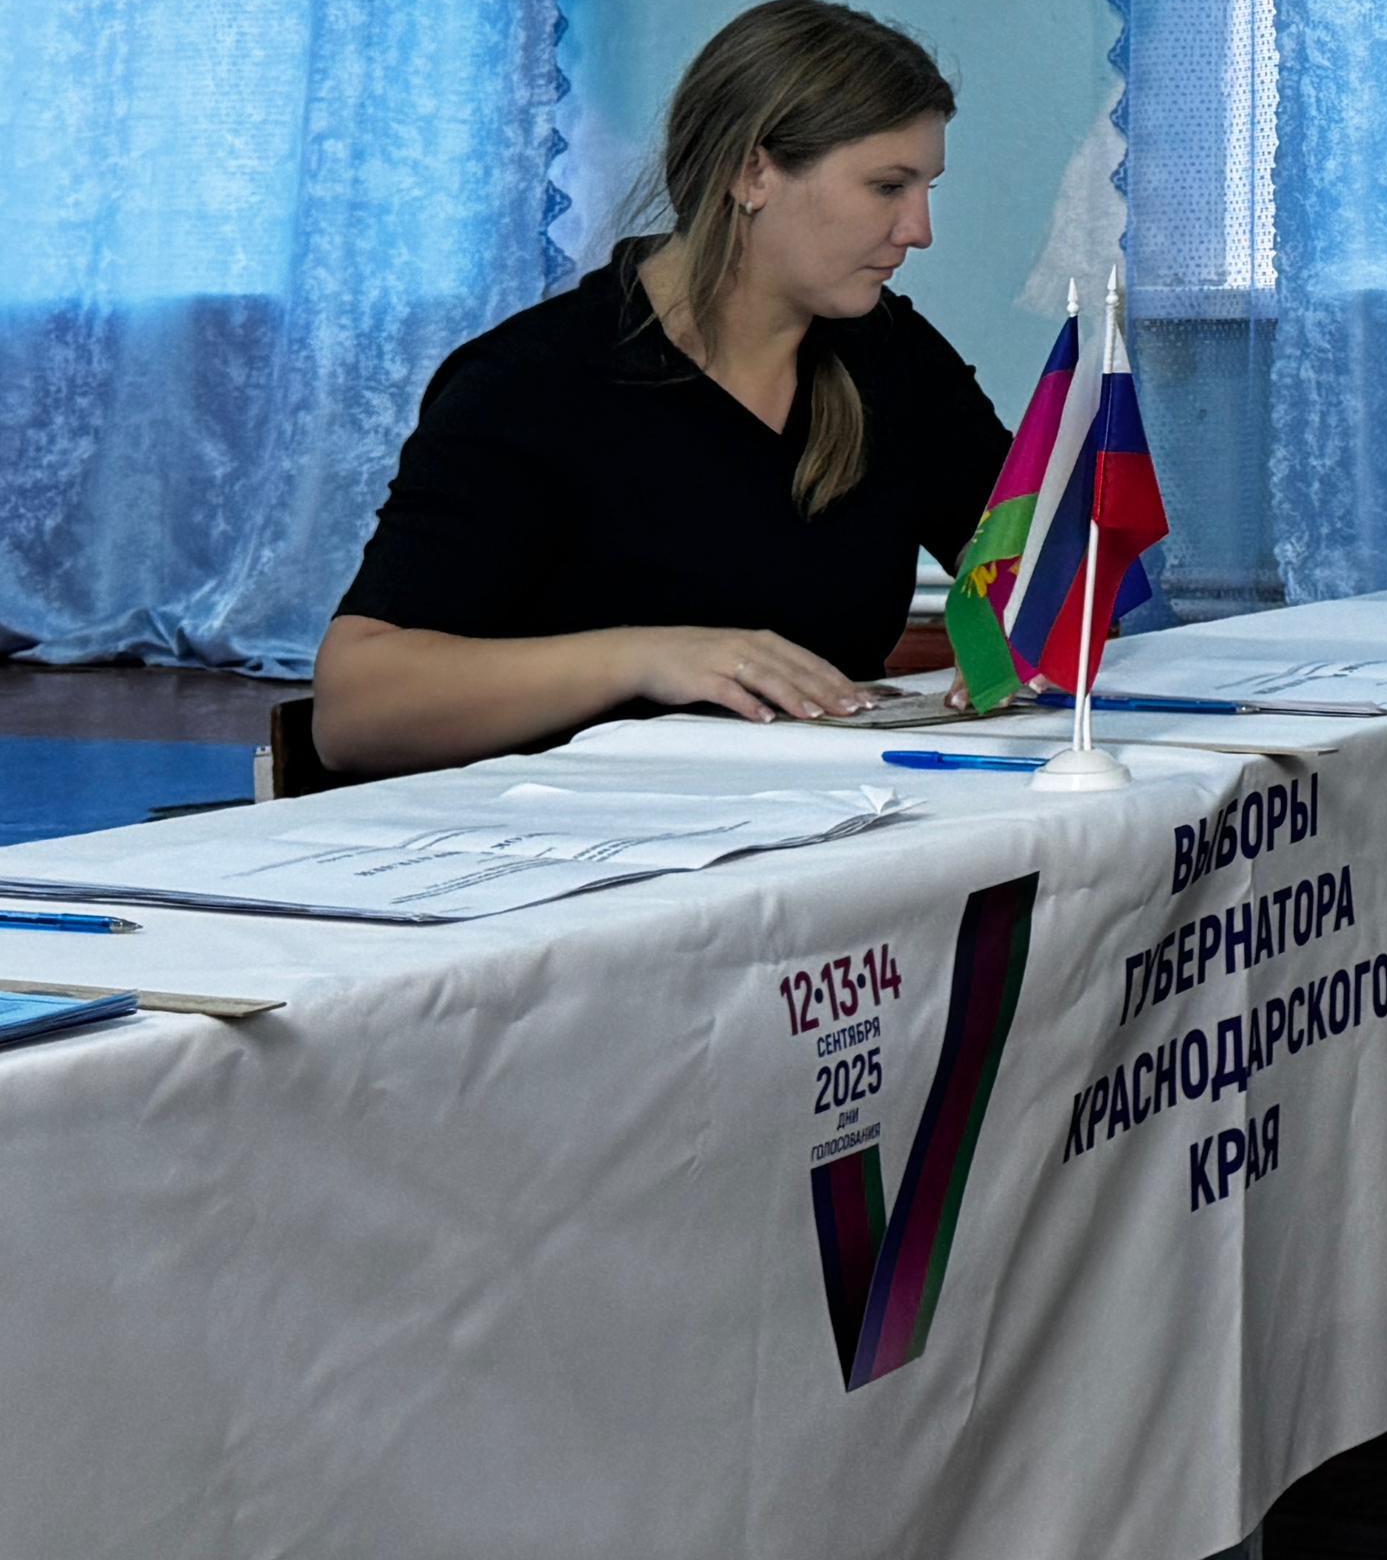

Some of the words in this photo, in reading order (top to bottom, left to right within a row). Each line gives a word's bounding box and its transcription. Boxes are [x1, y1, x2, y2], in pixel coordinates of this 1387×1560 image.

[1171, 772, 1319, 896] ВЫБОРЫ
[1119, 864, 1356, 1027] ГУБЕРНАТОРА
[816, 1015, 881, 1058] СЕНТЯБРЯ
[814, 1046, 883, 1115] 2025
[810, 1121, 881, 1163] ГОЛОСОВАНИЯ
[836, 1107, 859, 1131] ДНИ
[1189, 1103, 1281, 1213] КРАЯ
